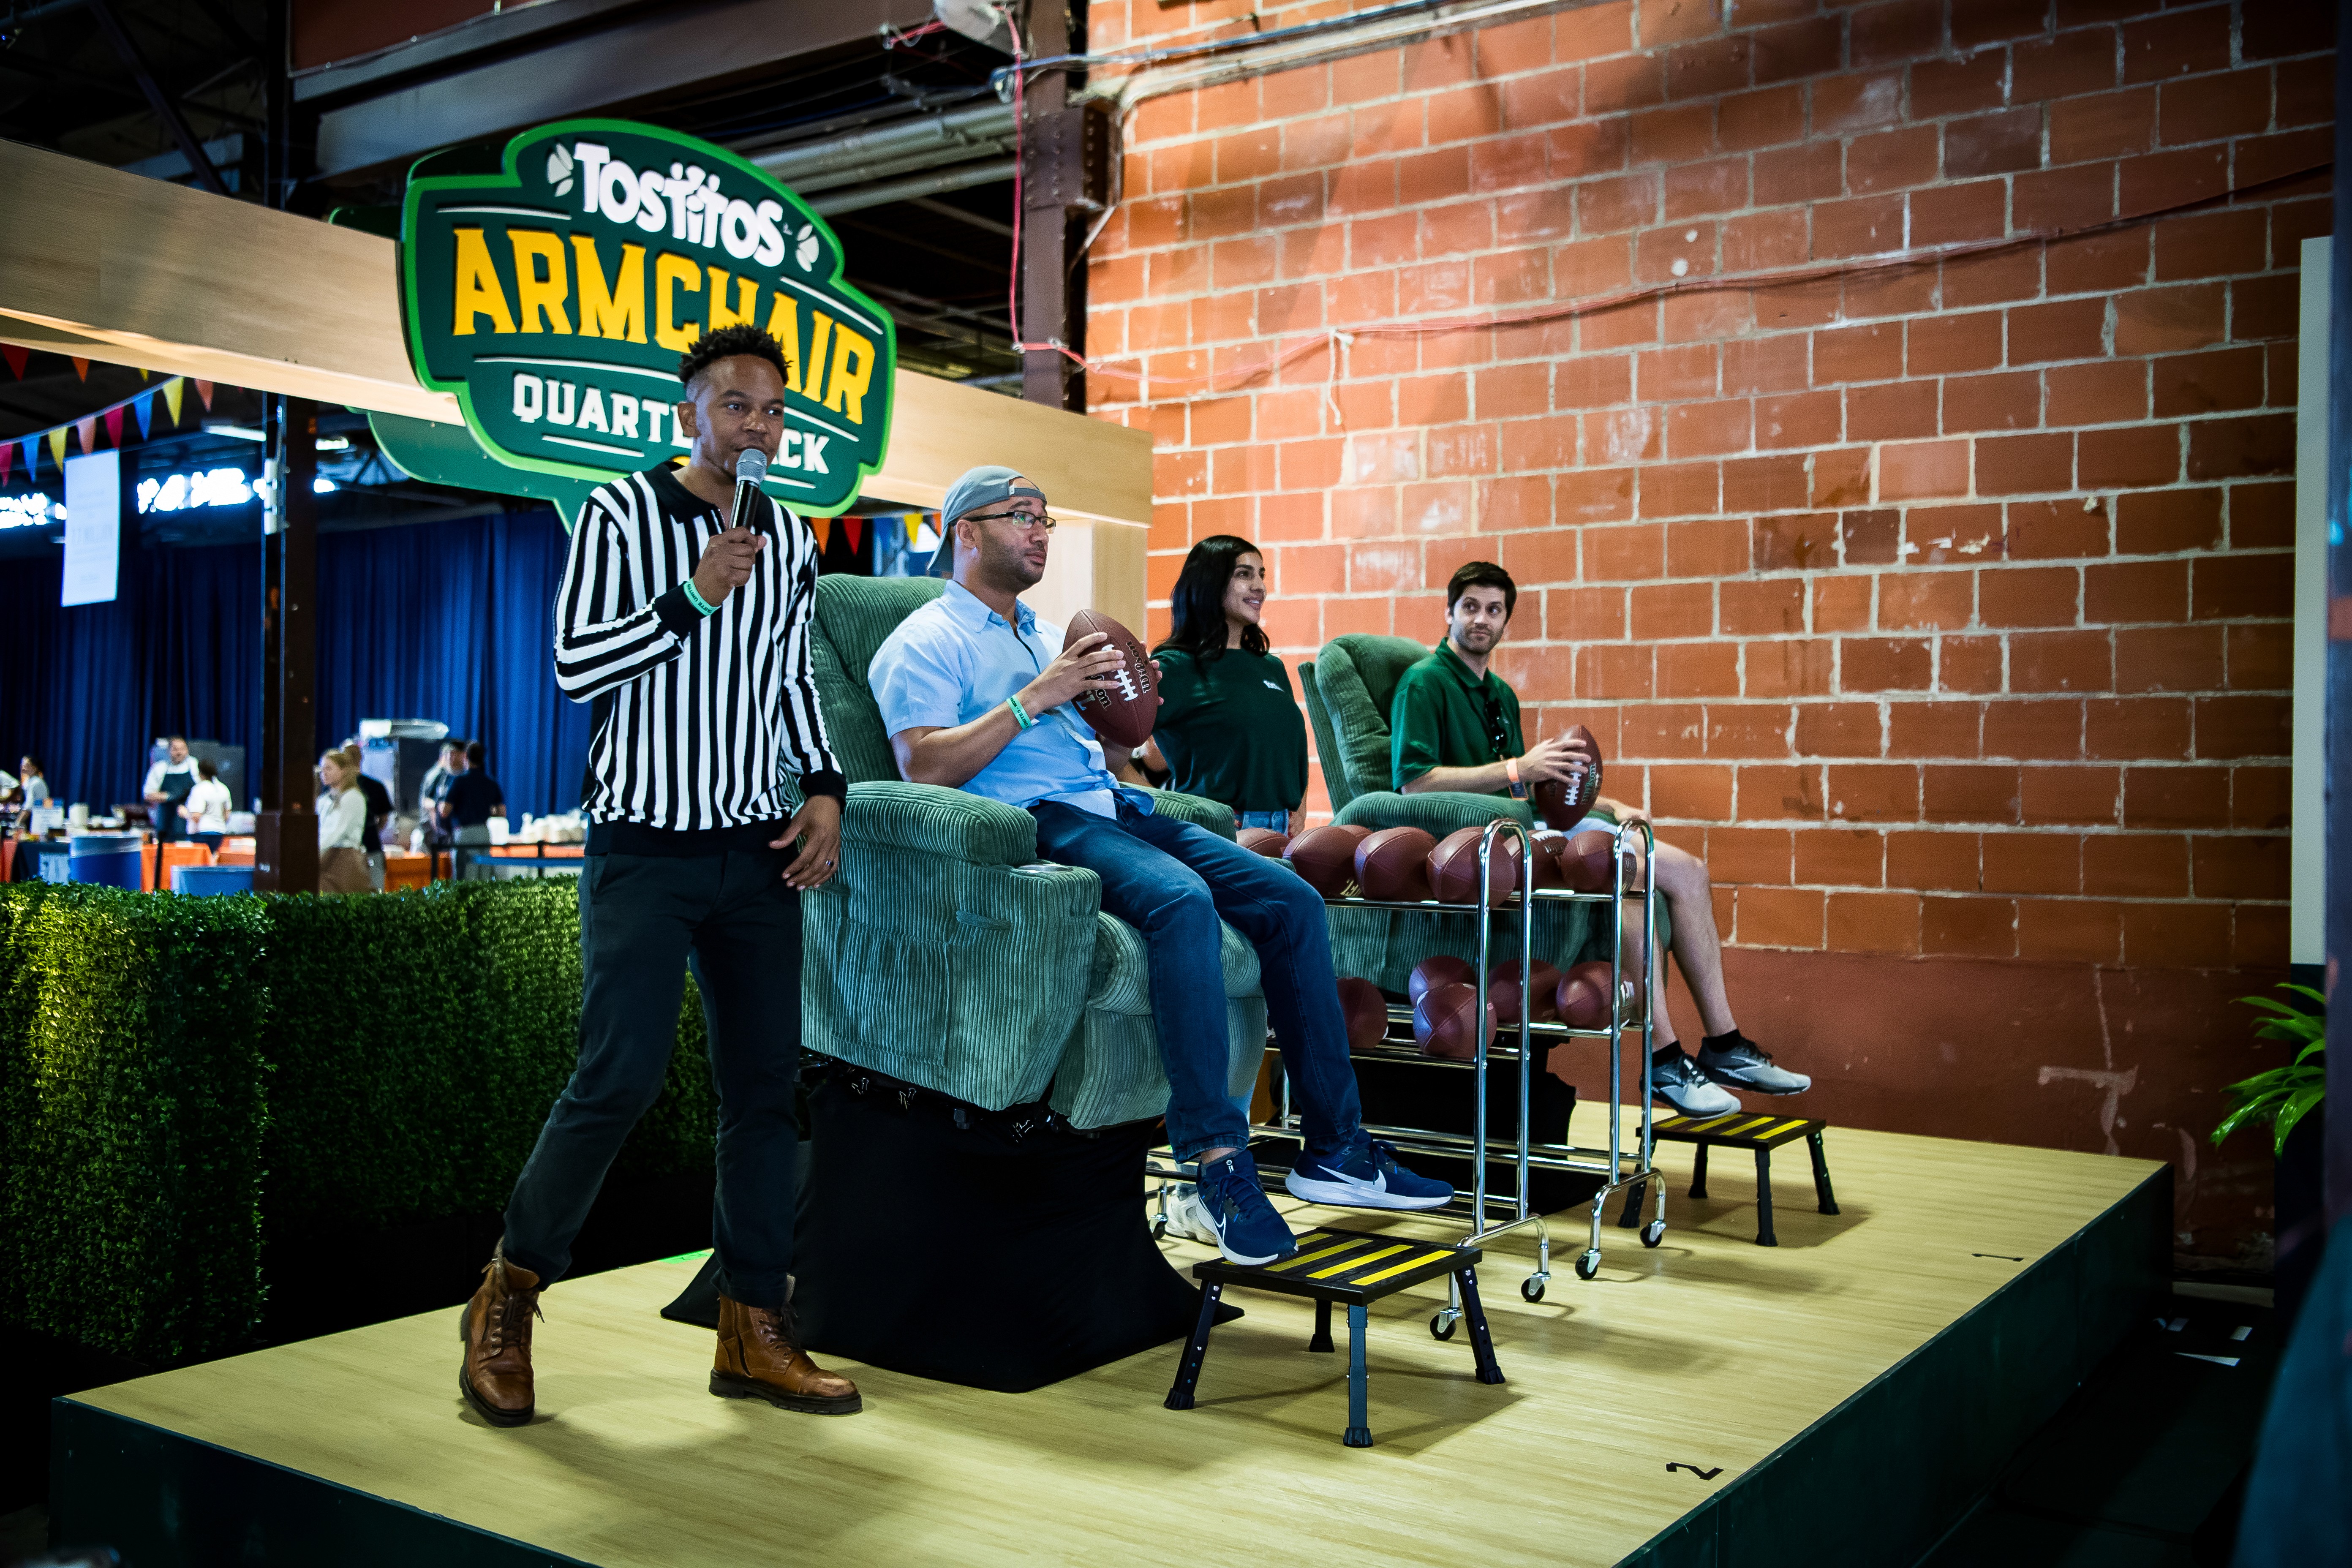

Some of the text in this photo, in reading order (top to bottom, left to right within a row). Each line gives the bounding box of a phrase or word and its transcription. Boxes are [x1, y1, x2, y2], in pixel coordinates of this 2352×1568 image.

[453, 228, 875, 425] ARMCHAIR
[513, 373, 830, 474] QUARTCK
[1126, 641, 1152, 694] Wilson
[1017, 709, 1029, 726] UNITED
[1666, 1462, 1724, 1481] 2
